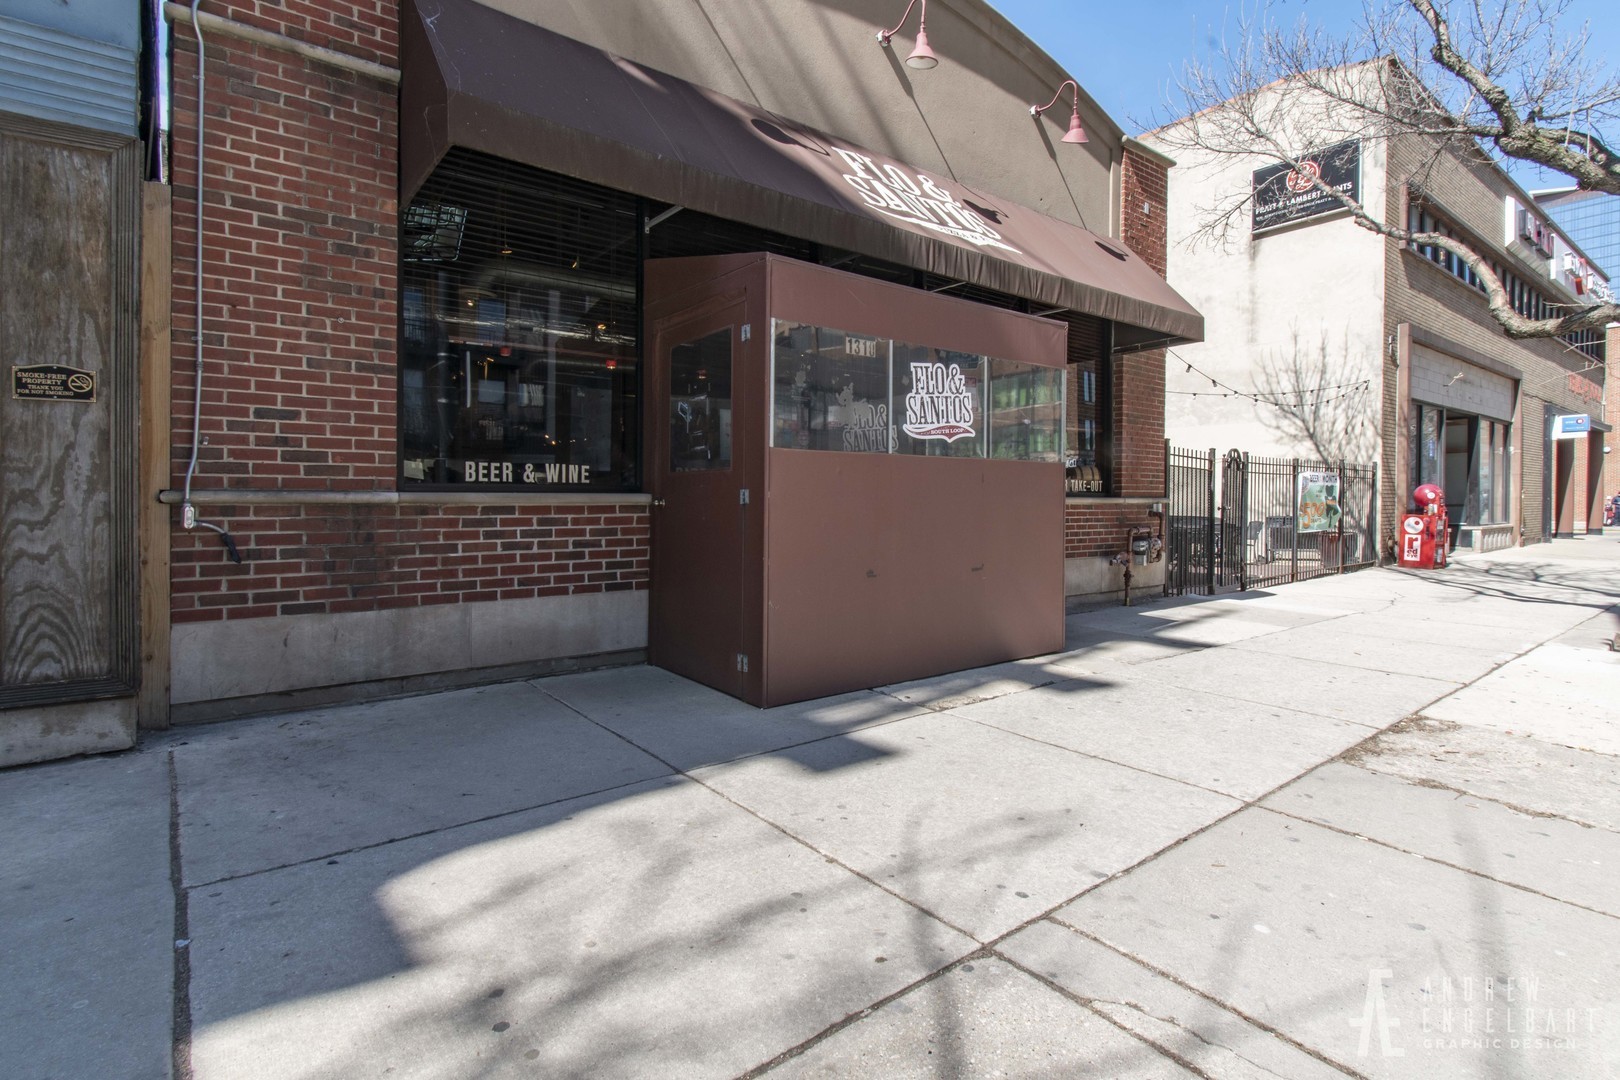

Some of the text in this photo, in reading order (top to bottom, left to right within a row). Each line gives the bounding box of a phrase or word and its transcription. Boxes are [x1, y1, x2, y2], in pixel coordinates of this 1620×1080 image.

[831, 146, 953, 203] FLO &
[843, 174, 1002, 239] SANTOS
[1255, 203, 1277, 214] PRATT
[1286, 190, 1322, 206] LAMBERT
[848, 338, 875, 357] 1310
[16, 372, 66, 380] SMOKE-FREE
[911, 363, 965, 396] FLO &
[908, 395, 973, 426] SANTOS
[464, 461, 590, 484] BEER & WINE
[1070, 480, 1102, 492] TAKE-OUT
